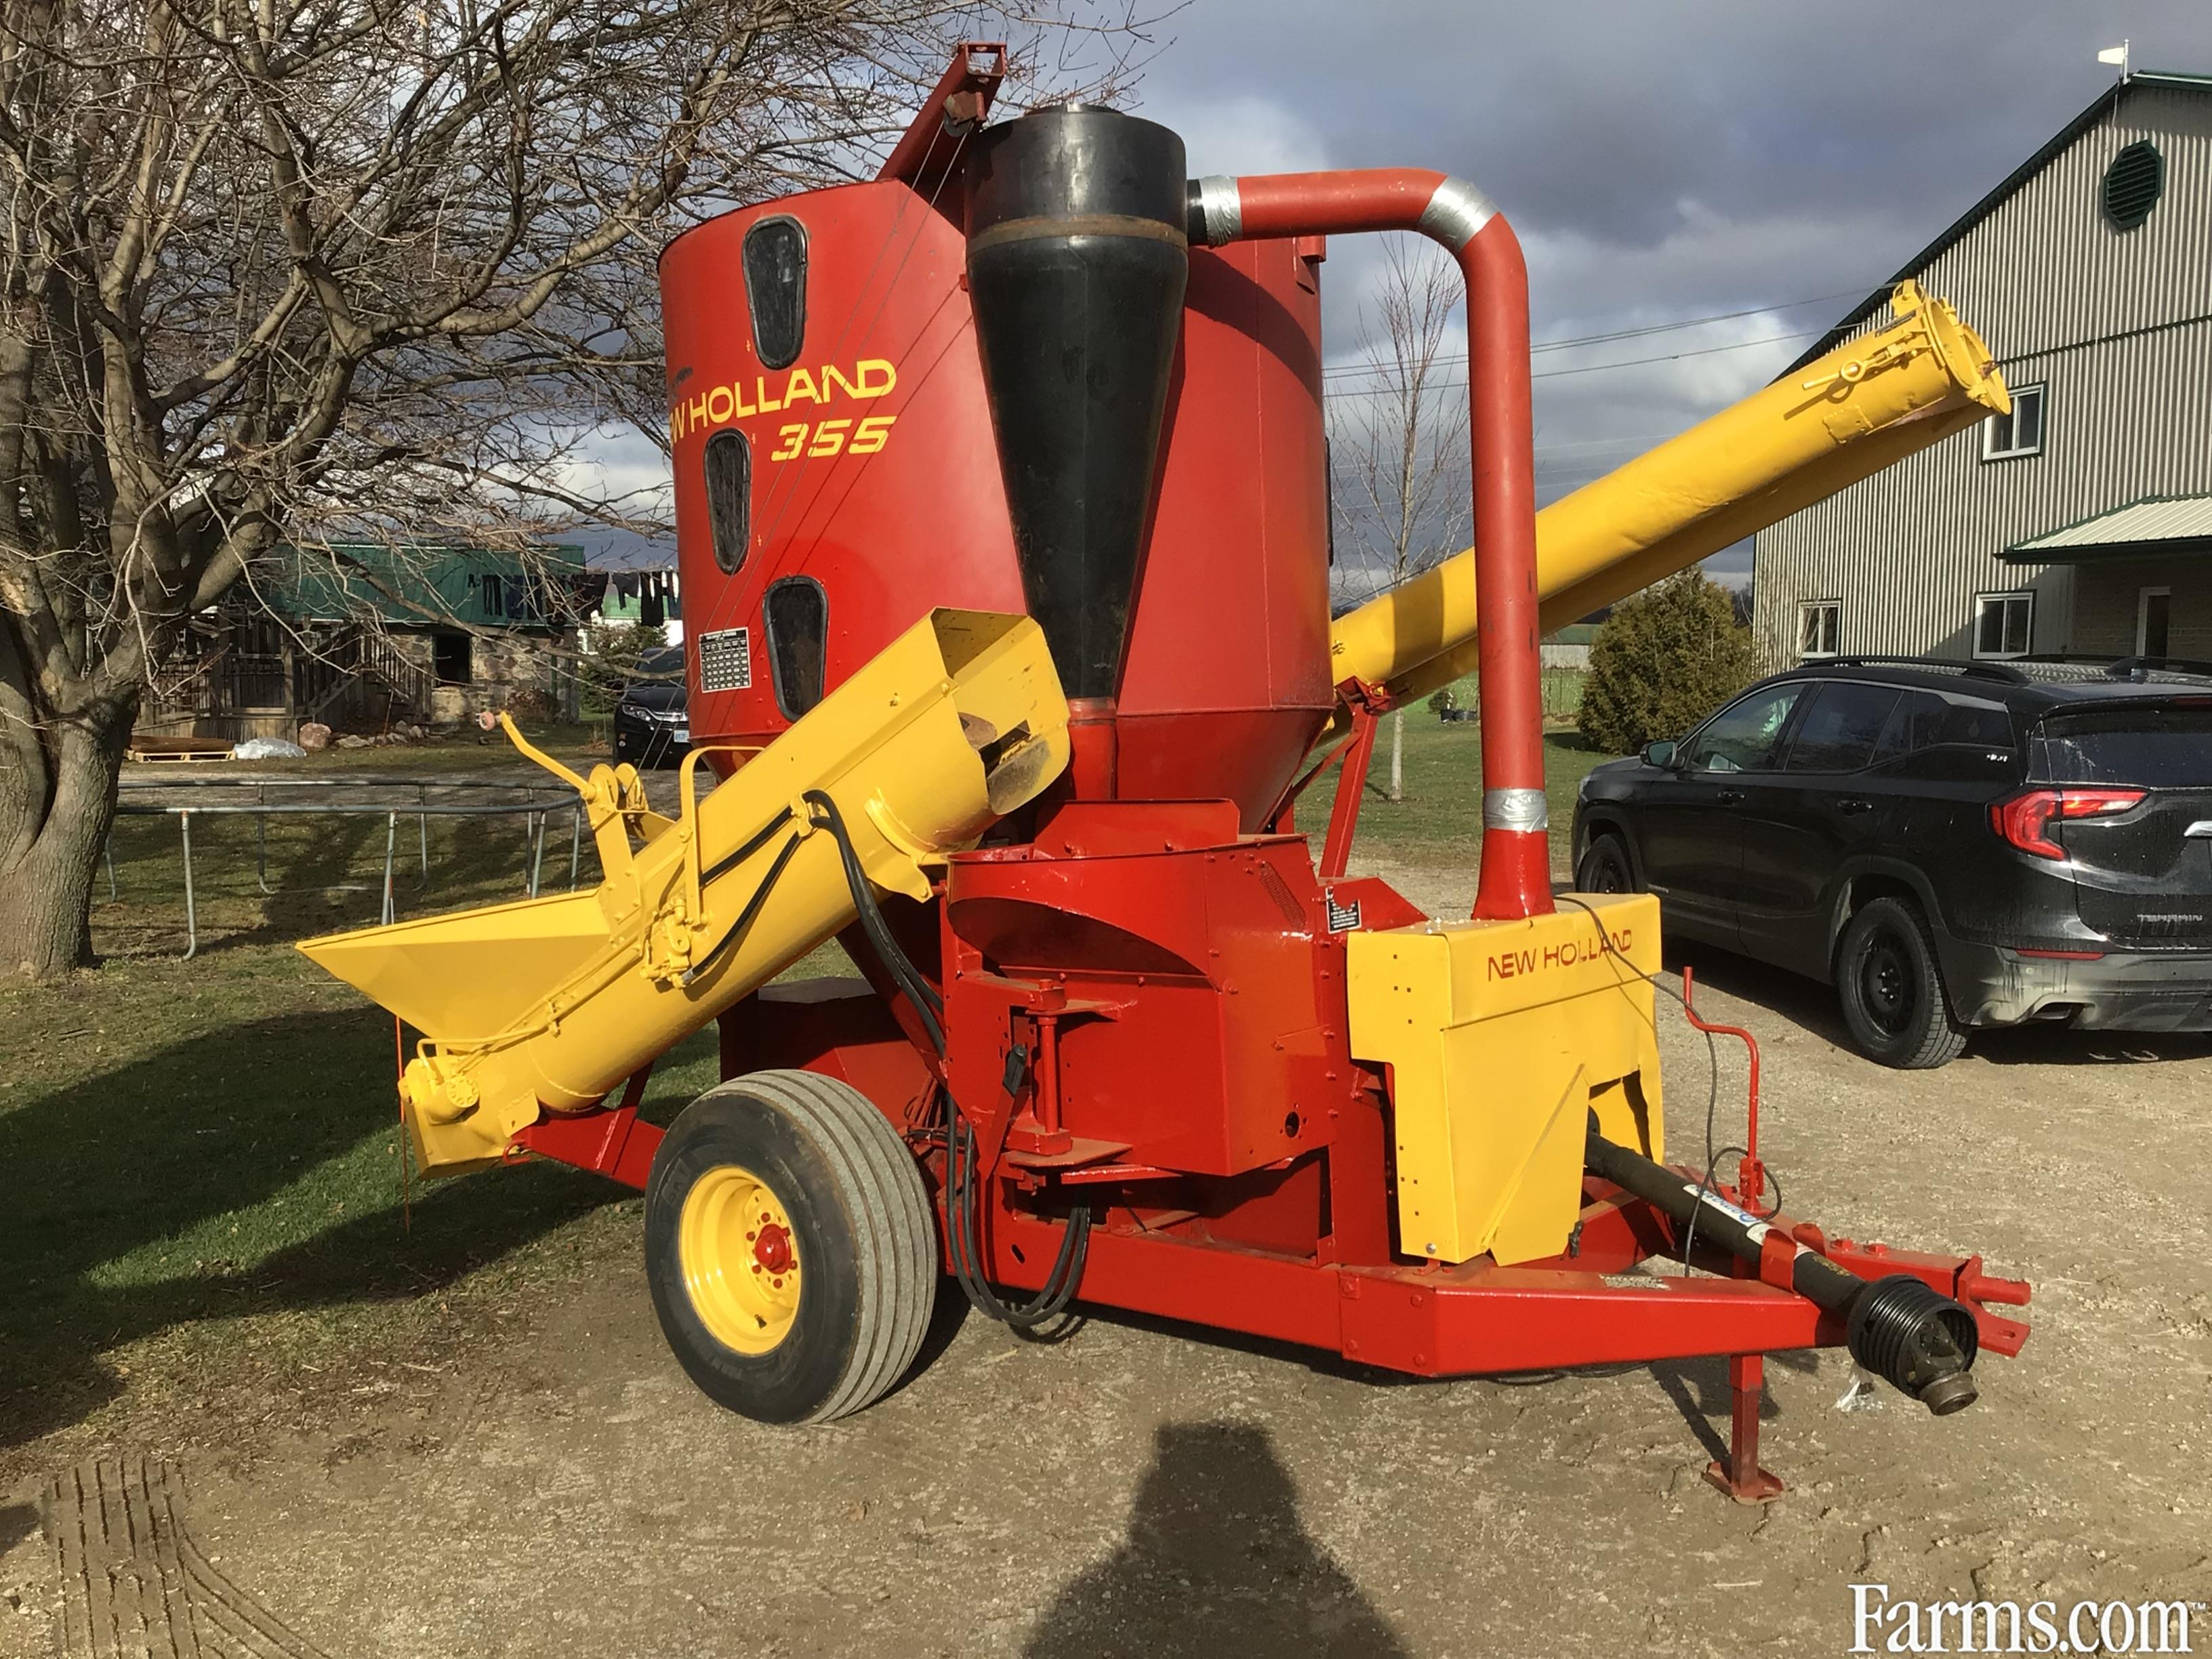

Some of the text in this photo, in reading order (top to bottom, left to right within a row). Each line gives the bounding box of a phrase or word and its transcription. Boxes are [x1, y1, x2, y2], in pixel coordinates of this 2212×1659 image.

[689, 359, 897, 433] HOLLAND
[771, 415, 897, 462] 355
[1488, 929, 1632, 982] NEW HOLLAND
